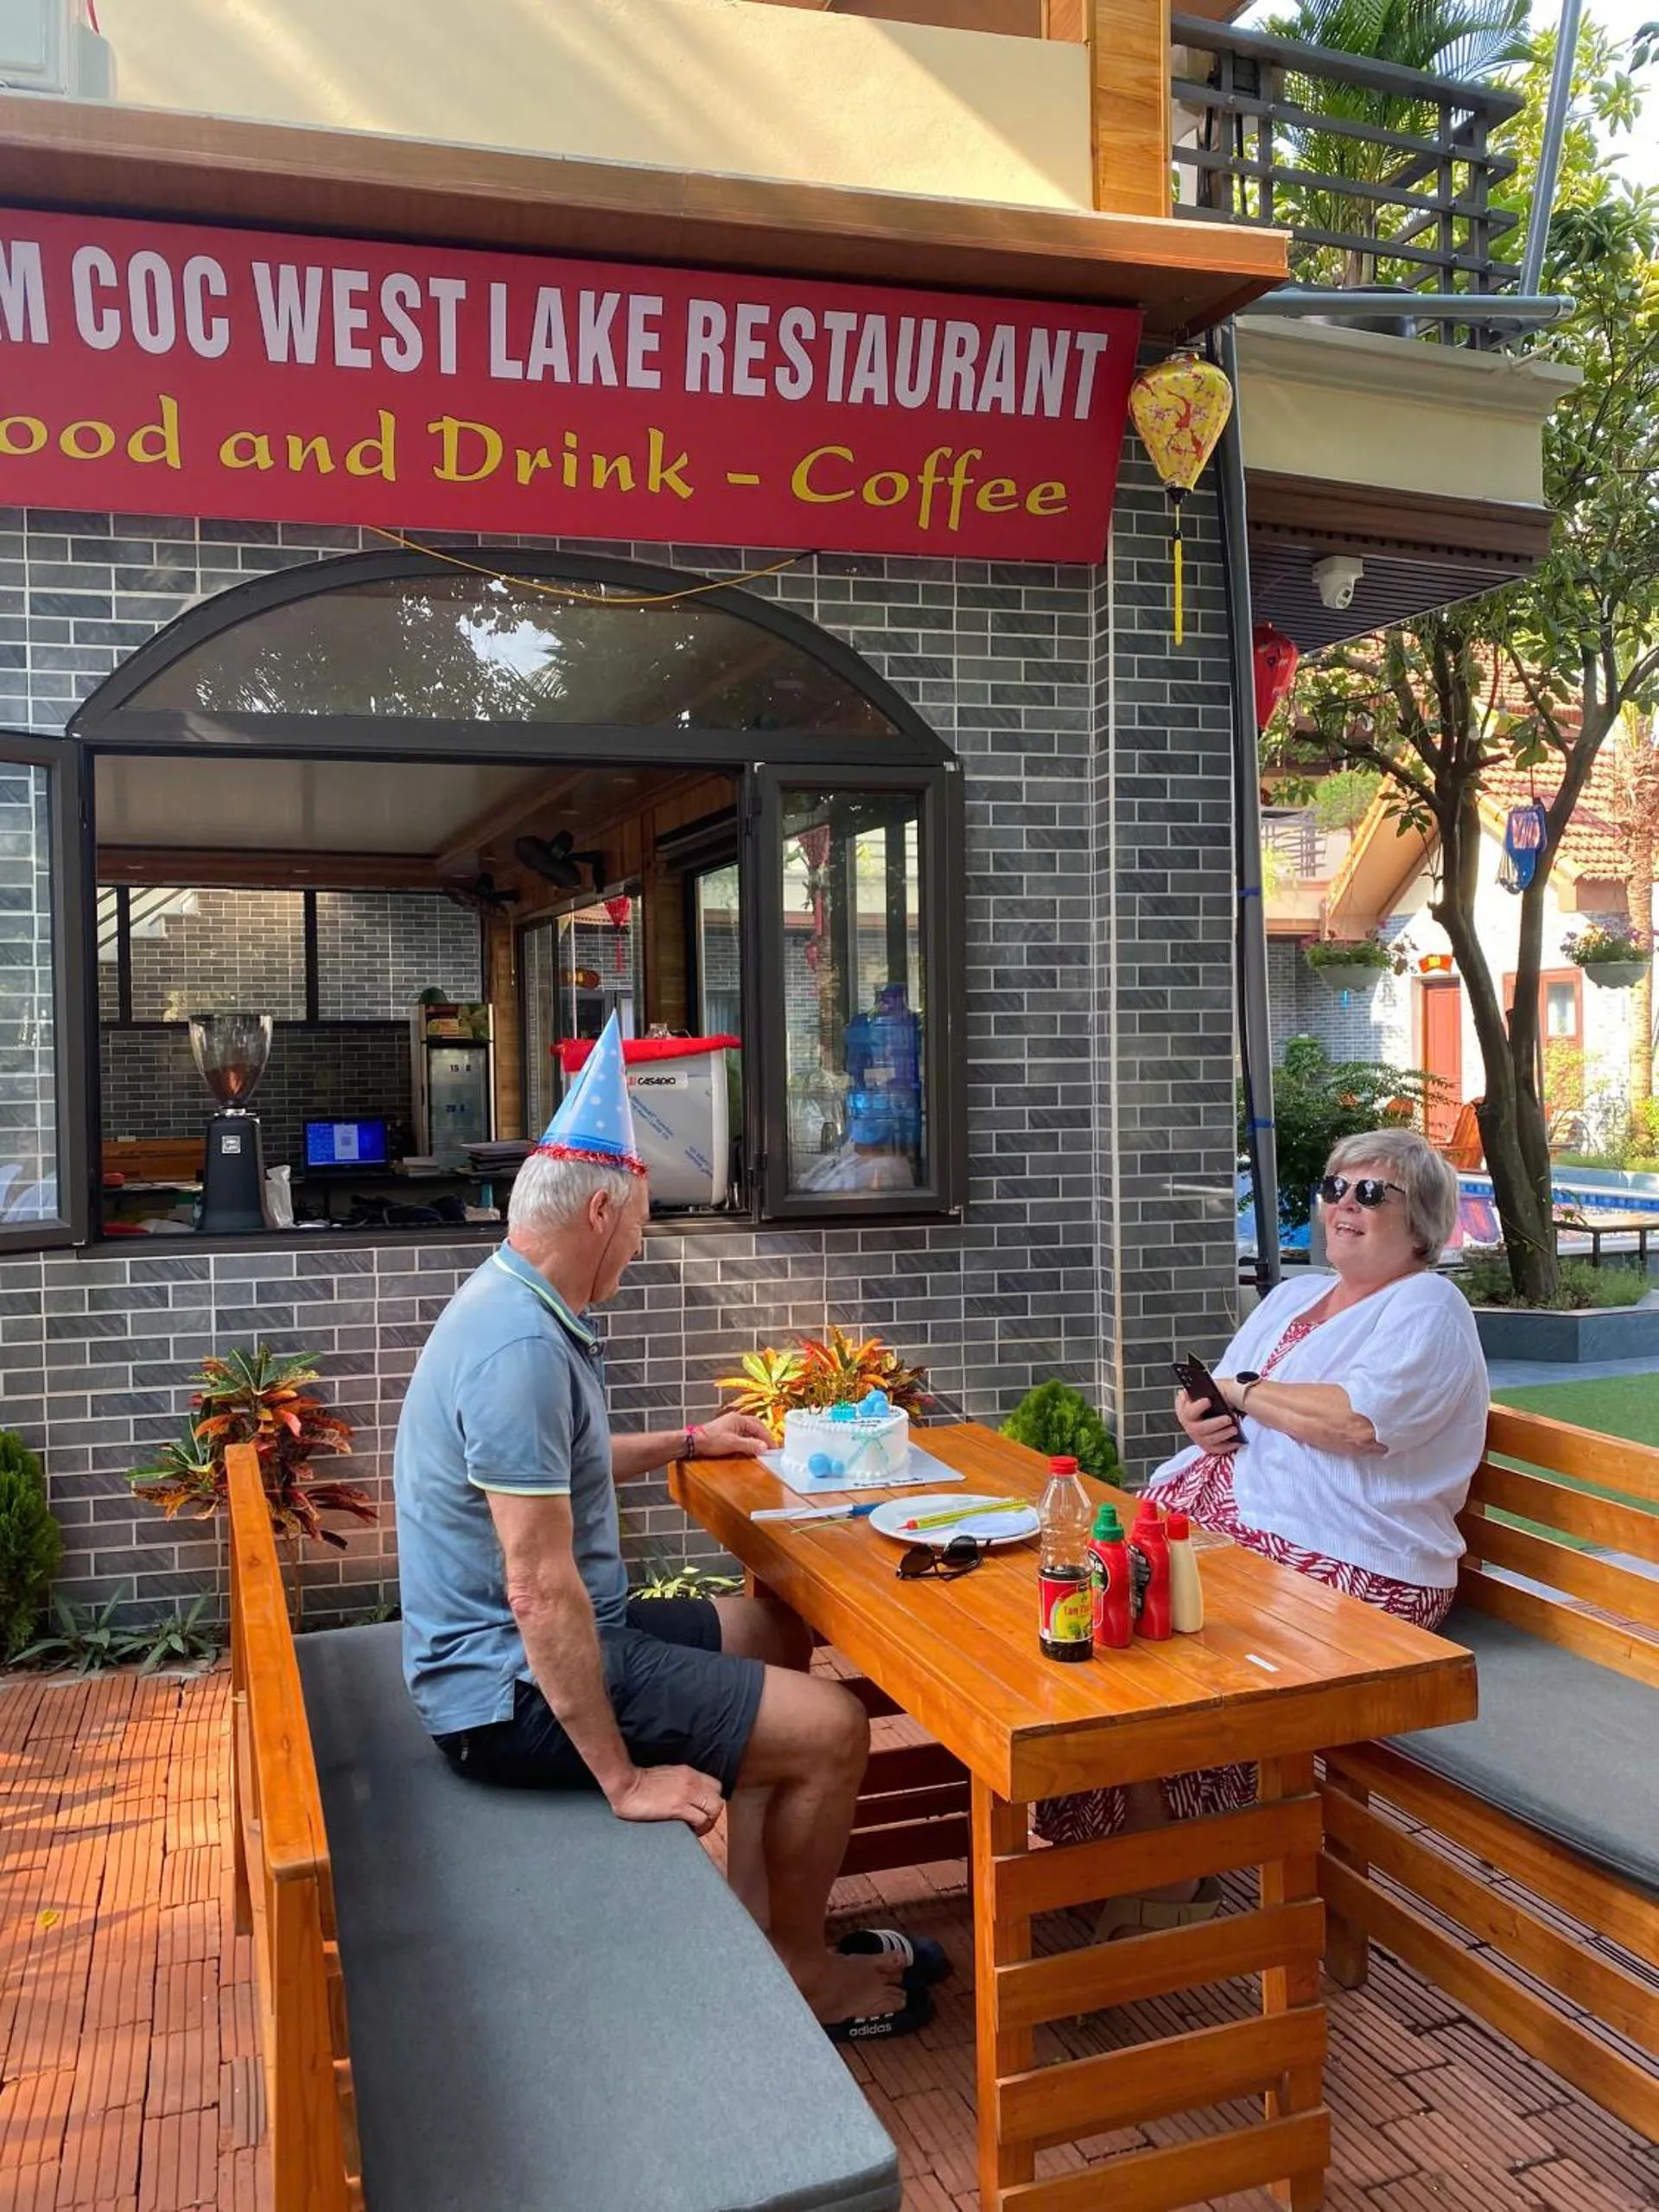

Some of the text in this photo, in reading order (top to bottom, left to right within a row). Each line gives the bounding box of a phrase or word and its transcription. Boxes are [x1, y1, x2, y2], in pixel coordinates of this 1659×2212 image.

[71, 245, 230, 359] COC
[251, 261, 467, 375] WEST
[489, 283, 664, 390] LAKE
[685, 298, 1109, 421] RESTAURANT
[219, 409, 397, 482] and
[428, 415, 694, 499] Drink
[791, 444, 1069, 531] Coffee
[849, 2023, 891, 2036] adidas
